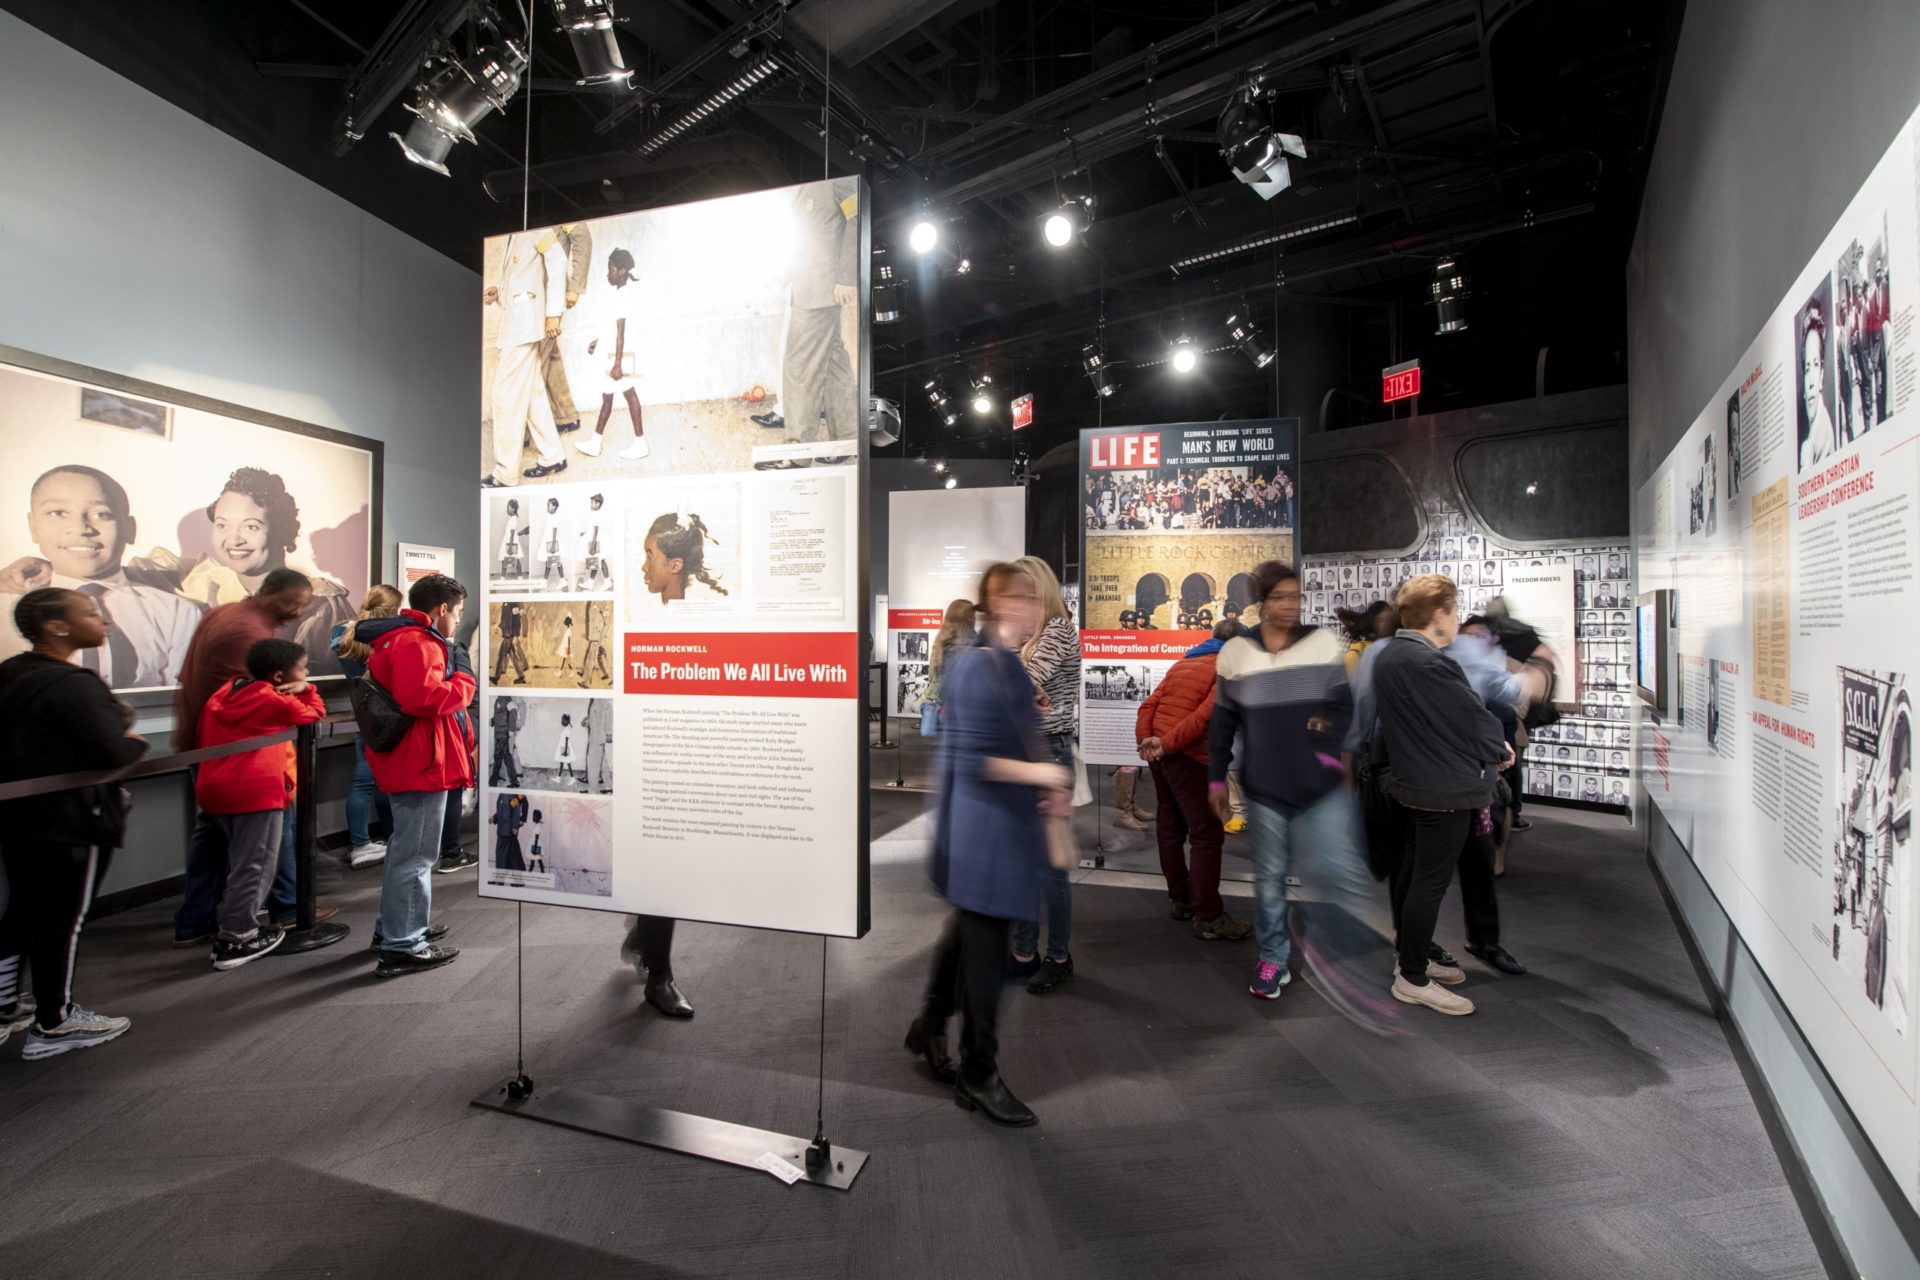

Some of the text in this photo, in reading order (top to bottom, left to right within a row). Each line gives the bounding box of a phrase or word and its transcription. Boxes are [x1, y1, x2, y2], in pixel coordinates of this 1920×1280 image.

[1092, 436, 1159, 467] LIFE
[1182, 438, 1274, 454] MAN'S NEW WORLD
[1186, 456, 1210, 464] TECHNICAL
[1244, 454, 1260, 462] SHAPE
[1798, 472, 1824, 500] SOUTHERN
[1826, 452, 1860, 485] CHRISTIAN
[1798, 493, 1829, 520] LEADERSHIP
[1831, 471, 1874, 507] CONFERENCE
[1102, 545, 1289, 560] LITTLE ROCK CENTRAL
[1100, 574, 1120, 582] TROOPS
[1090, 584, 1118, 592] TAKE OVER
[631, 644, 708, 653] NORMAN ROCKWELL
[1084, 643, 1100, 652] The
[1101, 643, 1146, 654] Integration
[1150, 644, 1160, 653] of
[631, 662, 846, 683] The Problem We All Live With
[1772, 719, 1780, 734] FOR
[1781, 722, 1796, 742] HUMAN
[1798, 728, 1815, 749] RIGHTS
